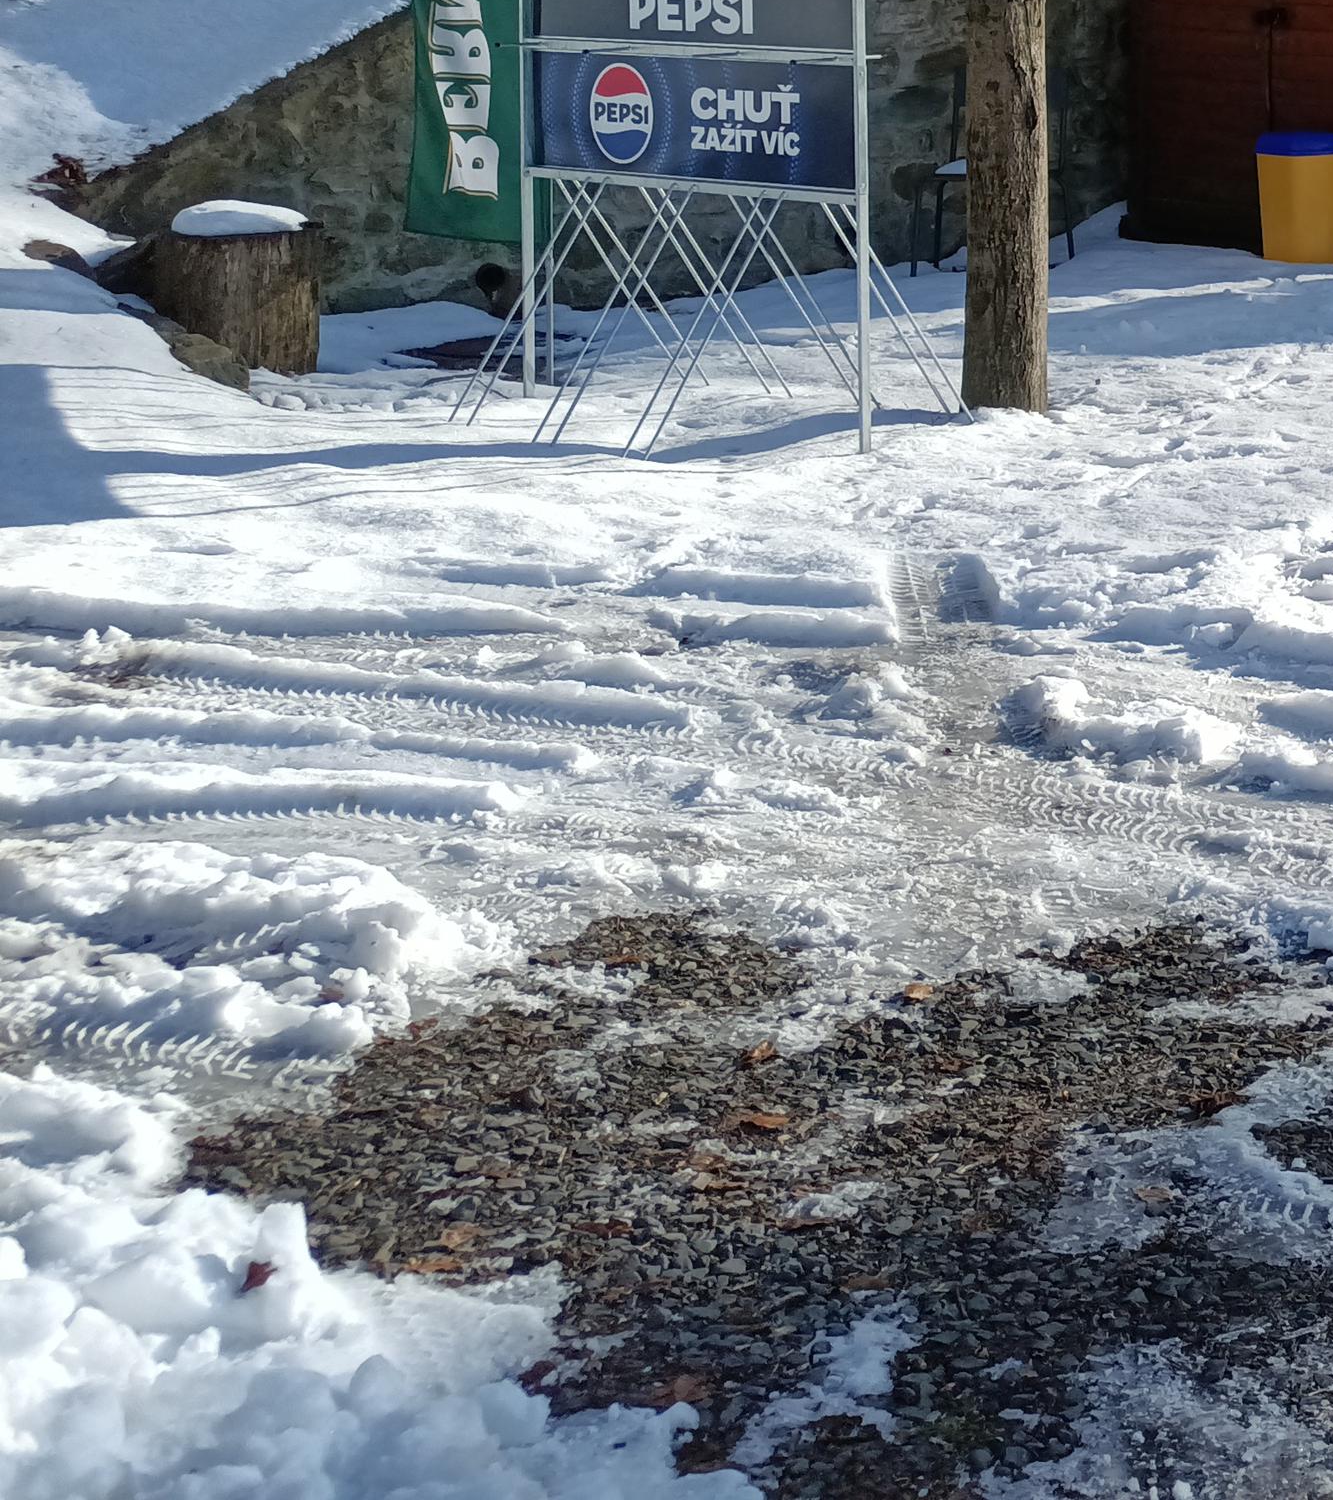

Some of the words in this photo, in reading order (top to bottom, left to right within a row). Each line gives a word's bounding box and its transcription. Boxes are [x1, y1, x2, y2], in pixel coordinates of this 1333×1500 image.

[594, 101, 649, 125] PEPSI
[690, 83, 800, 125] CHUŤ
[690, 123, 757, 155] ZAŽÍT
[761, 125, 800, 157] VÍC
